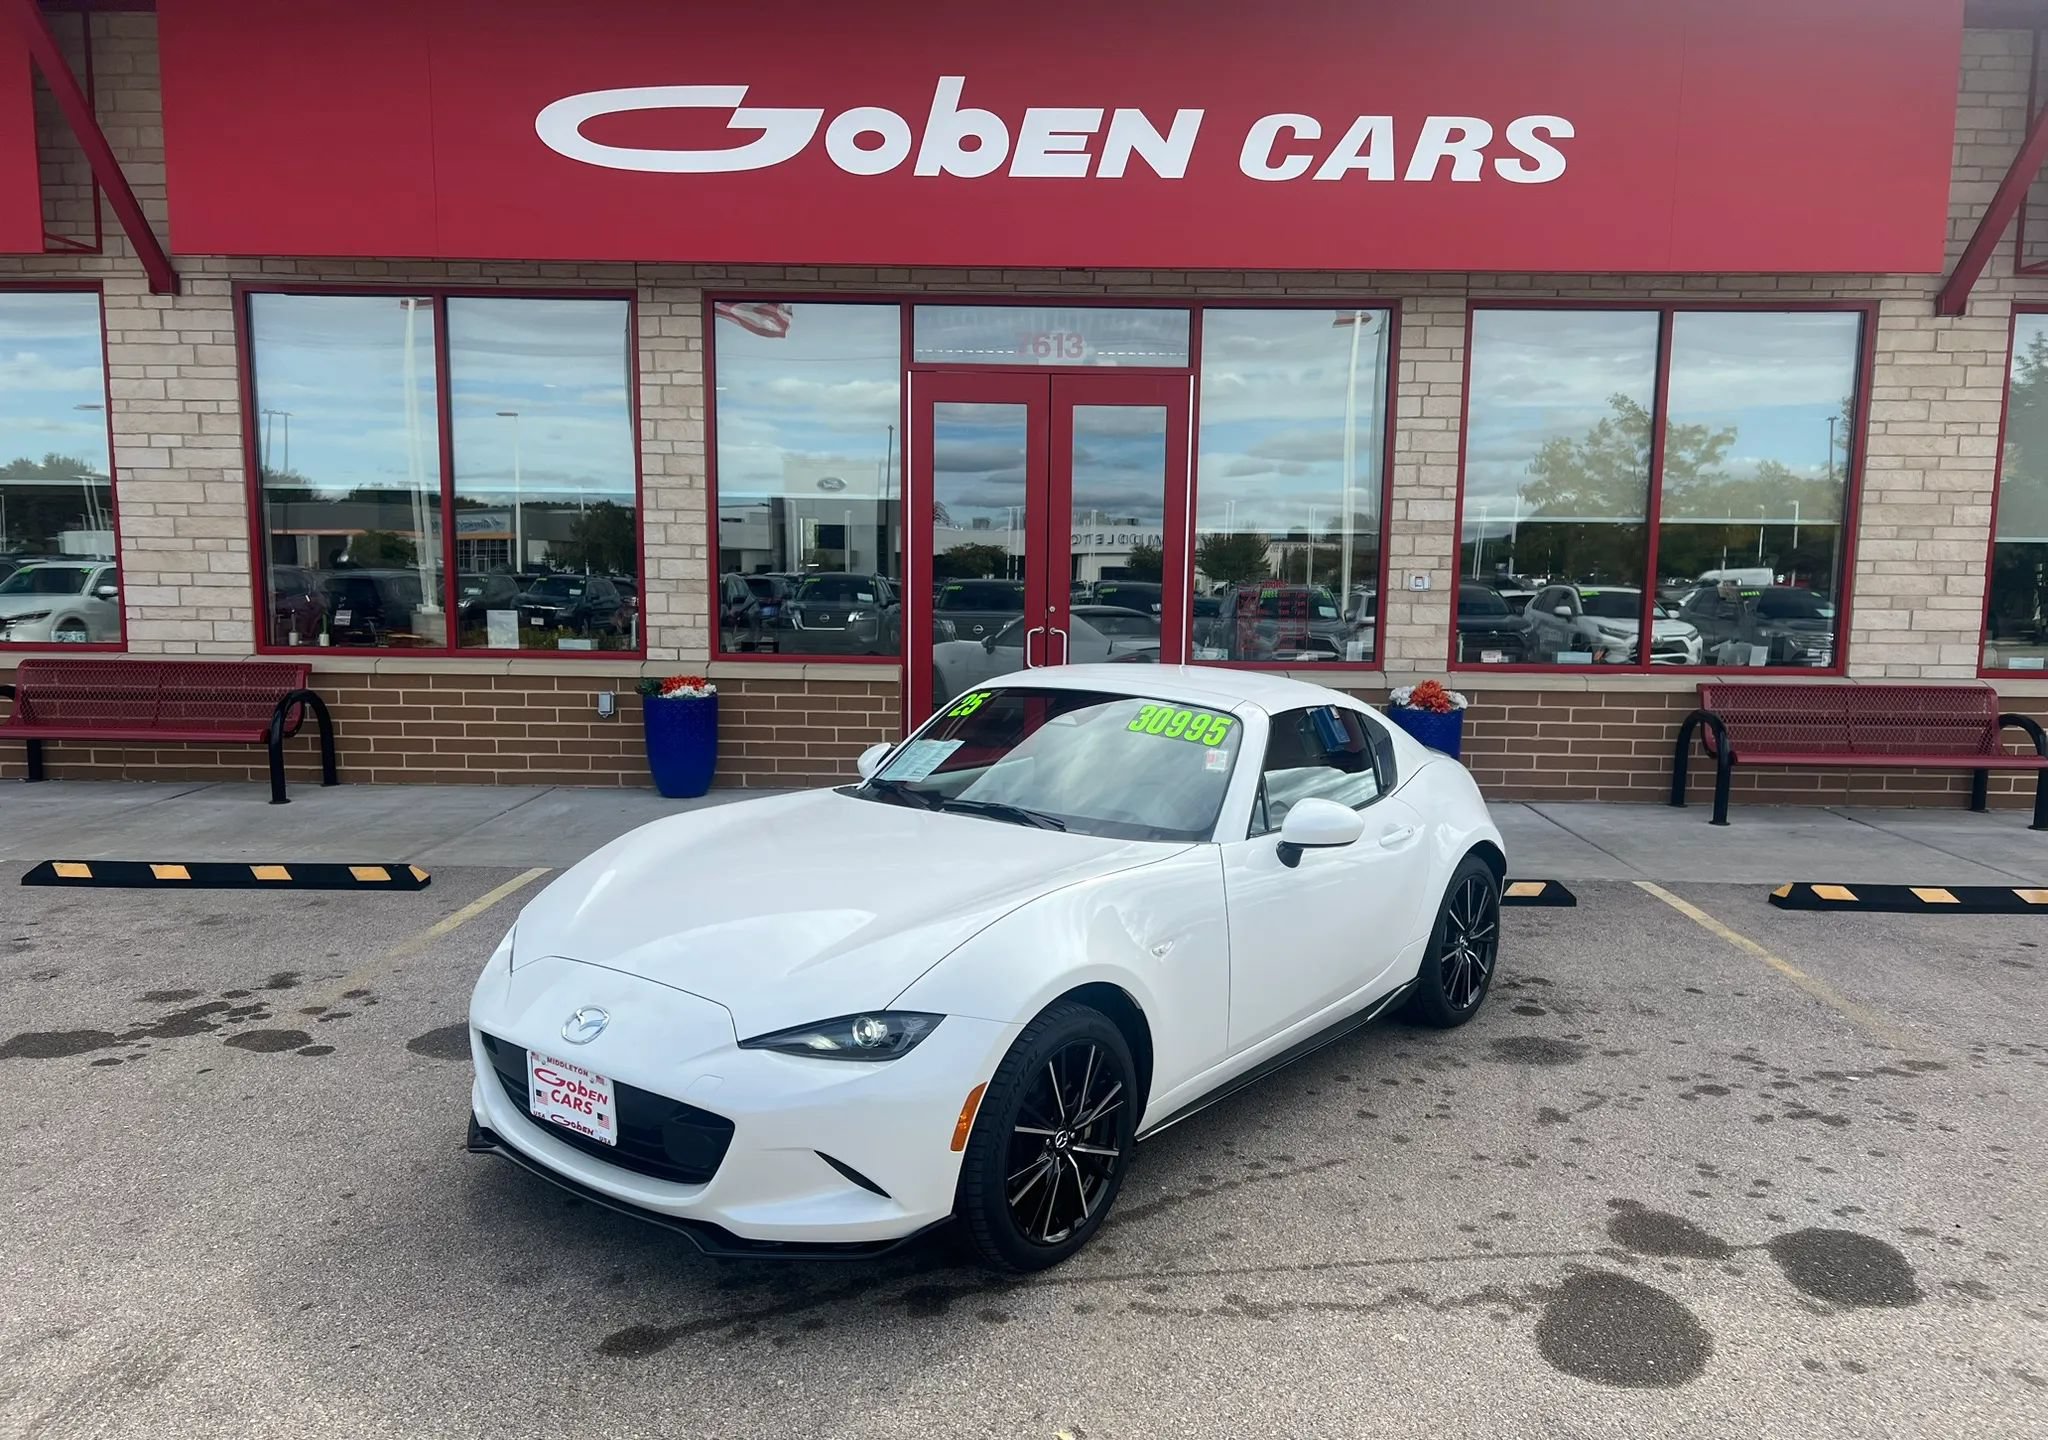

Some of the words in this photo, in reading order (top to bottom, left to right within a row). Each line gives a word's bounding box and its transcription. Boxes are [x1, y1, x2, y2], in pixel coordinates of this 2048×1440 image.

[1239, 113, 1575, 184] CARS
[1016, 332, 1083, 358] 7613
[1128, 704, 1232, 747] 30995
[547, 1057, 588, 1077] MIDDLETON
[533, 1110, 545, 1119] USA
[551, 1089, 593, 1115] CARS
